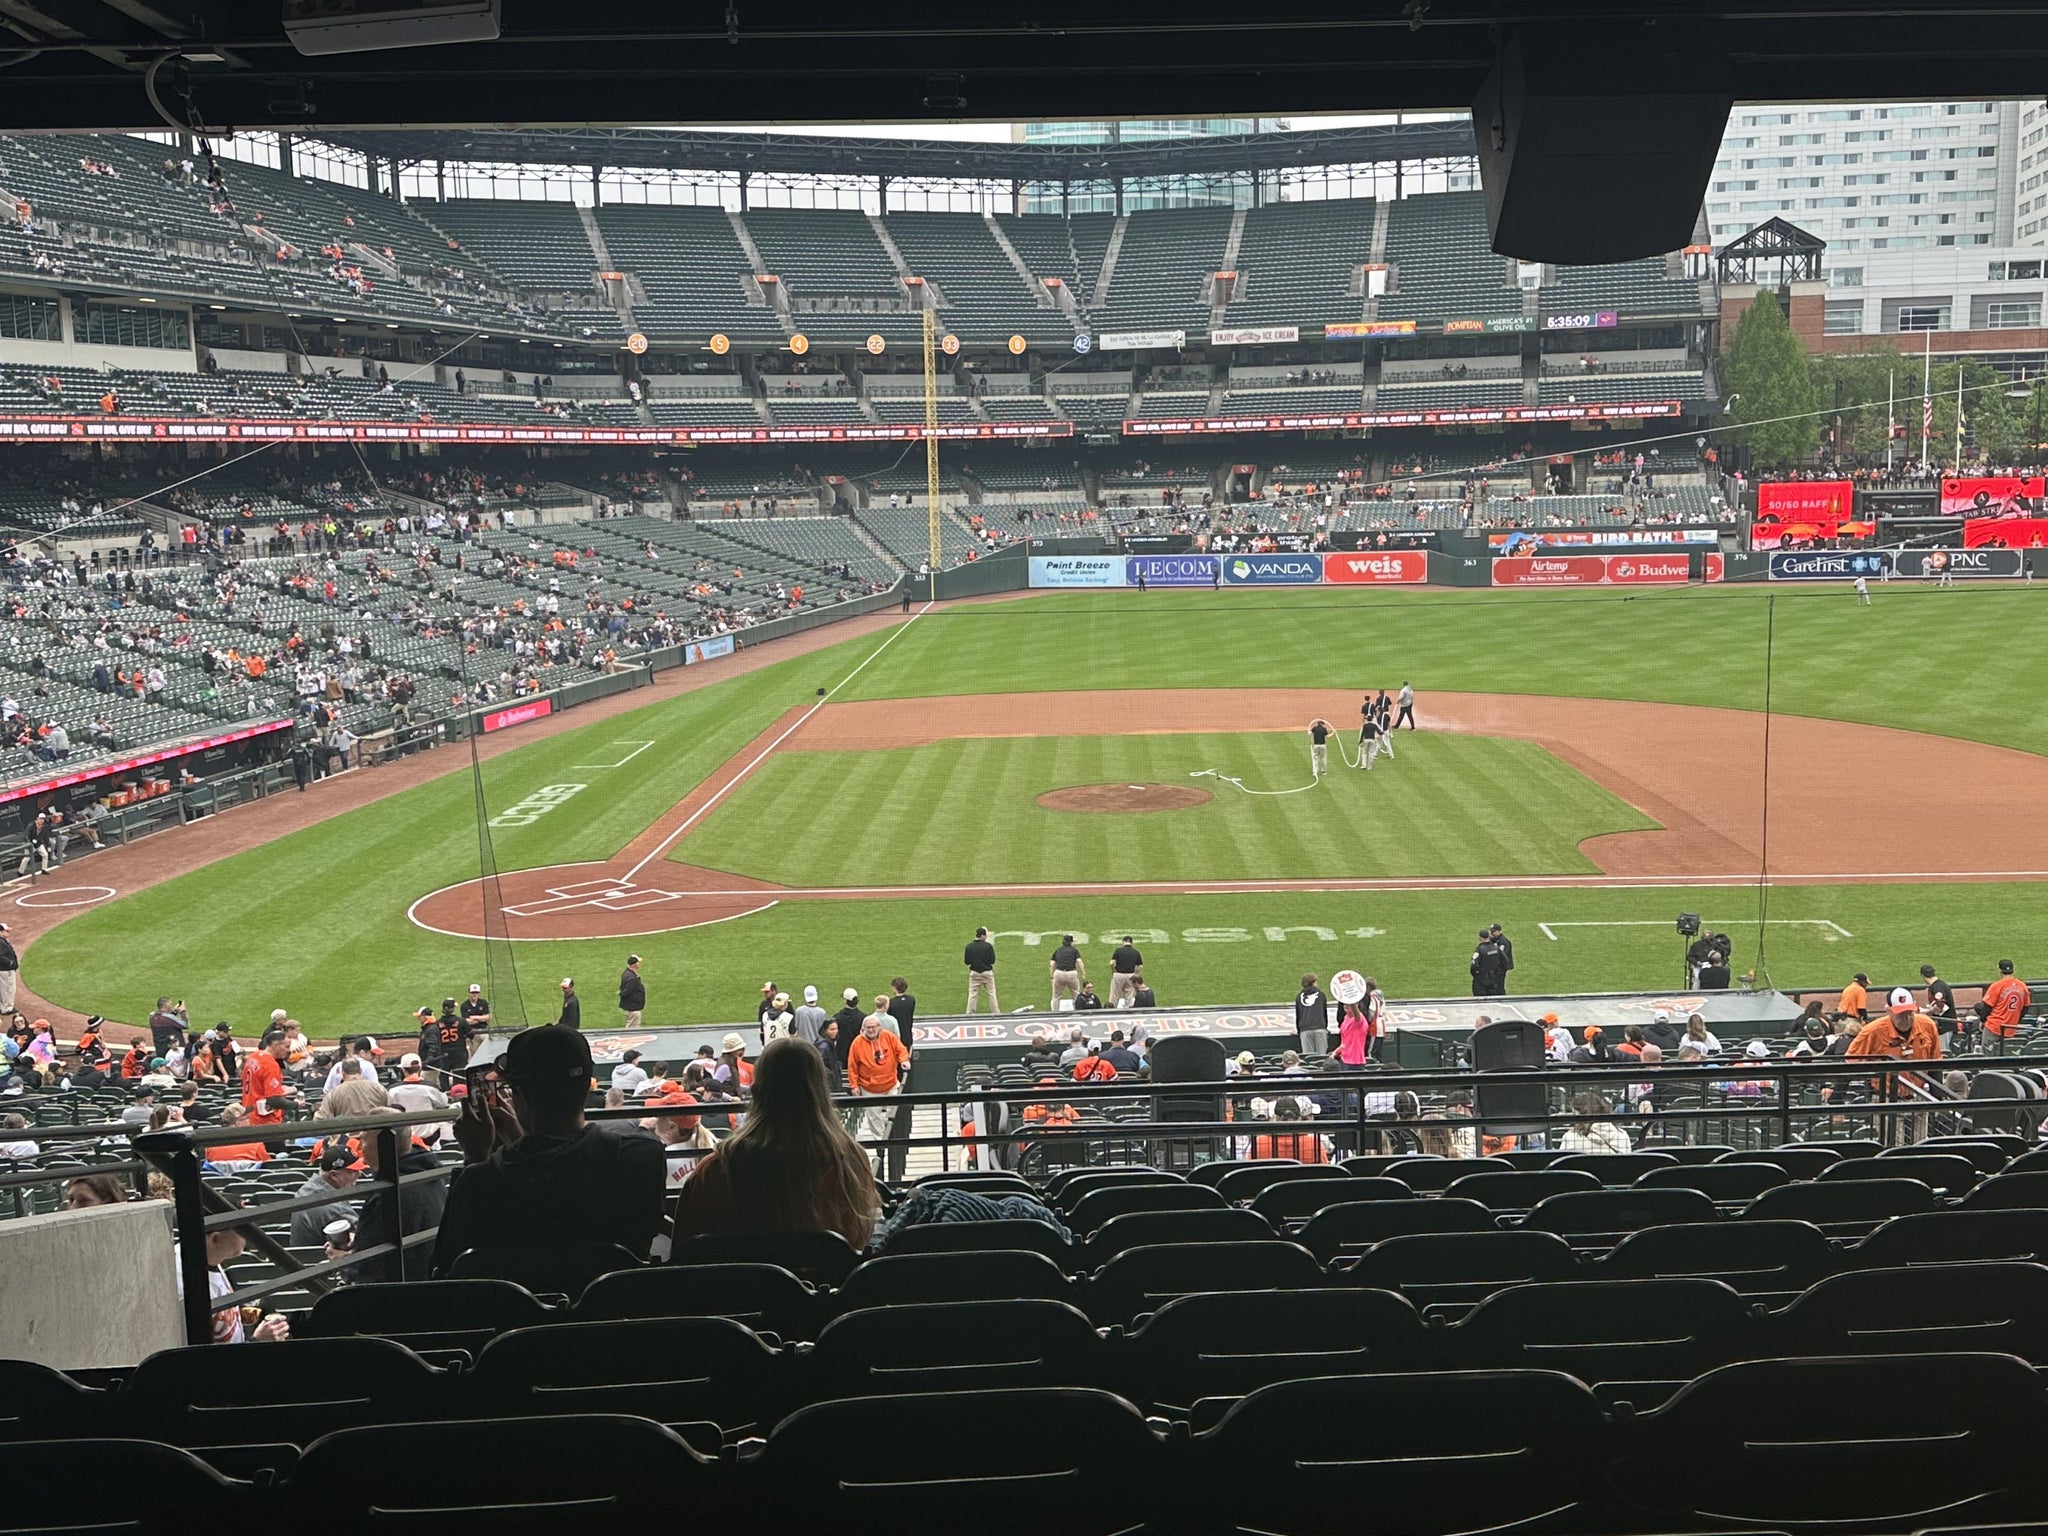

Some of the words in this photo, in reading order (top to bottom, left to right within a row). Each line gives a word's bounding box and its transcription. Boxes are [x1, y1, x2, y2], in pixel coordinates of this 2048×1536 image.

[1487, 318, 1523, 326] AMERICA'S
[1547, 315, 1591, 328] 5:35:09
[1216, 333, 1234, 342] ENJOY
[1263, 332, 1272, 340] ICE
[1275, 330, 1294, 339] CREAM
[631, 338, 645, 349] 20
[716, 338, 723, 350] 5
[795, 340, 802, 350] 4
[870, 340, 882, 350] 22
[944, 340, 956, 350] 33
[1014, 339, 1020, 350] 8
[1076, 338, 1088, 349] 42
[30, 424, 50, 434] GIVE
[1768, 501, 1800, 510] 50/50
[1592, 532, 1630, 544] BIRD
[1633, 532, 1672, 542] BATH
[1075, 561, 1110, 570] Breeze
[1347, 556, 1403, 574] weis
[1783, 557, 1848, 573] CareFirst
[1950, 553, 1987, 566] PNC
[1134, 561, 1213, 576] LECOM
[1251, 563, 1314, 574] VANDA
[1530, 560, 1569, 572] Airtemp
[2008, 995, 2018, 1010] 2
[1091, 1014, 1211, 1035] THE
[440, 1028, 459, 1043] 25
[770, 1025, 776, 1038] 2
